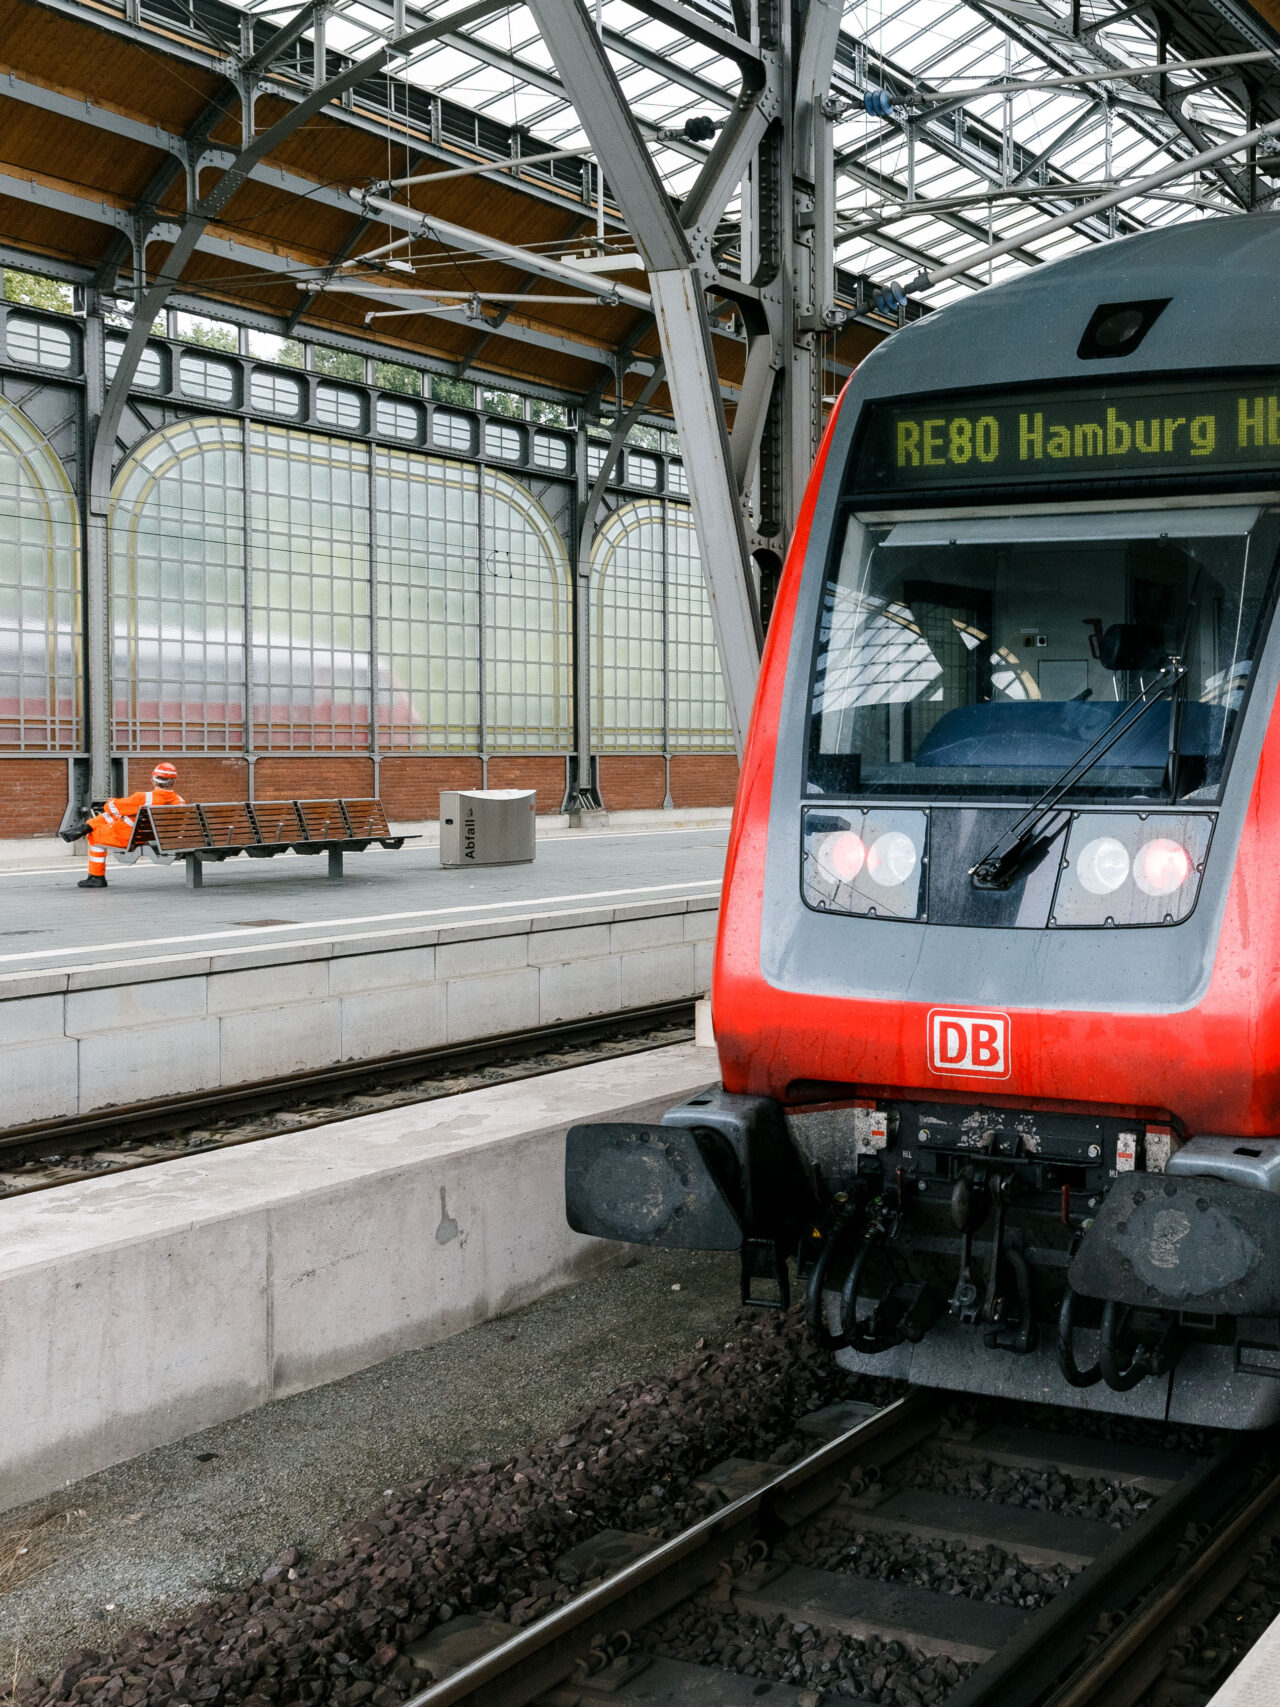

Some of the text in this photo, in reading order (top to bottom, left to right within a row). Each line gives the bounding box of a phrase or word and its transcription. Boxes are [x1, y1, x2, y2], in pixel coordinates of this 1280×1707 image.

[896, 416, 1000, 467] RE80
[1019, 408, 1216, 461] Hamburg
[465, 819, 476, 859] Abfall
[939, 1020, 1000, 1067] DB
